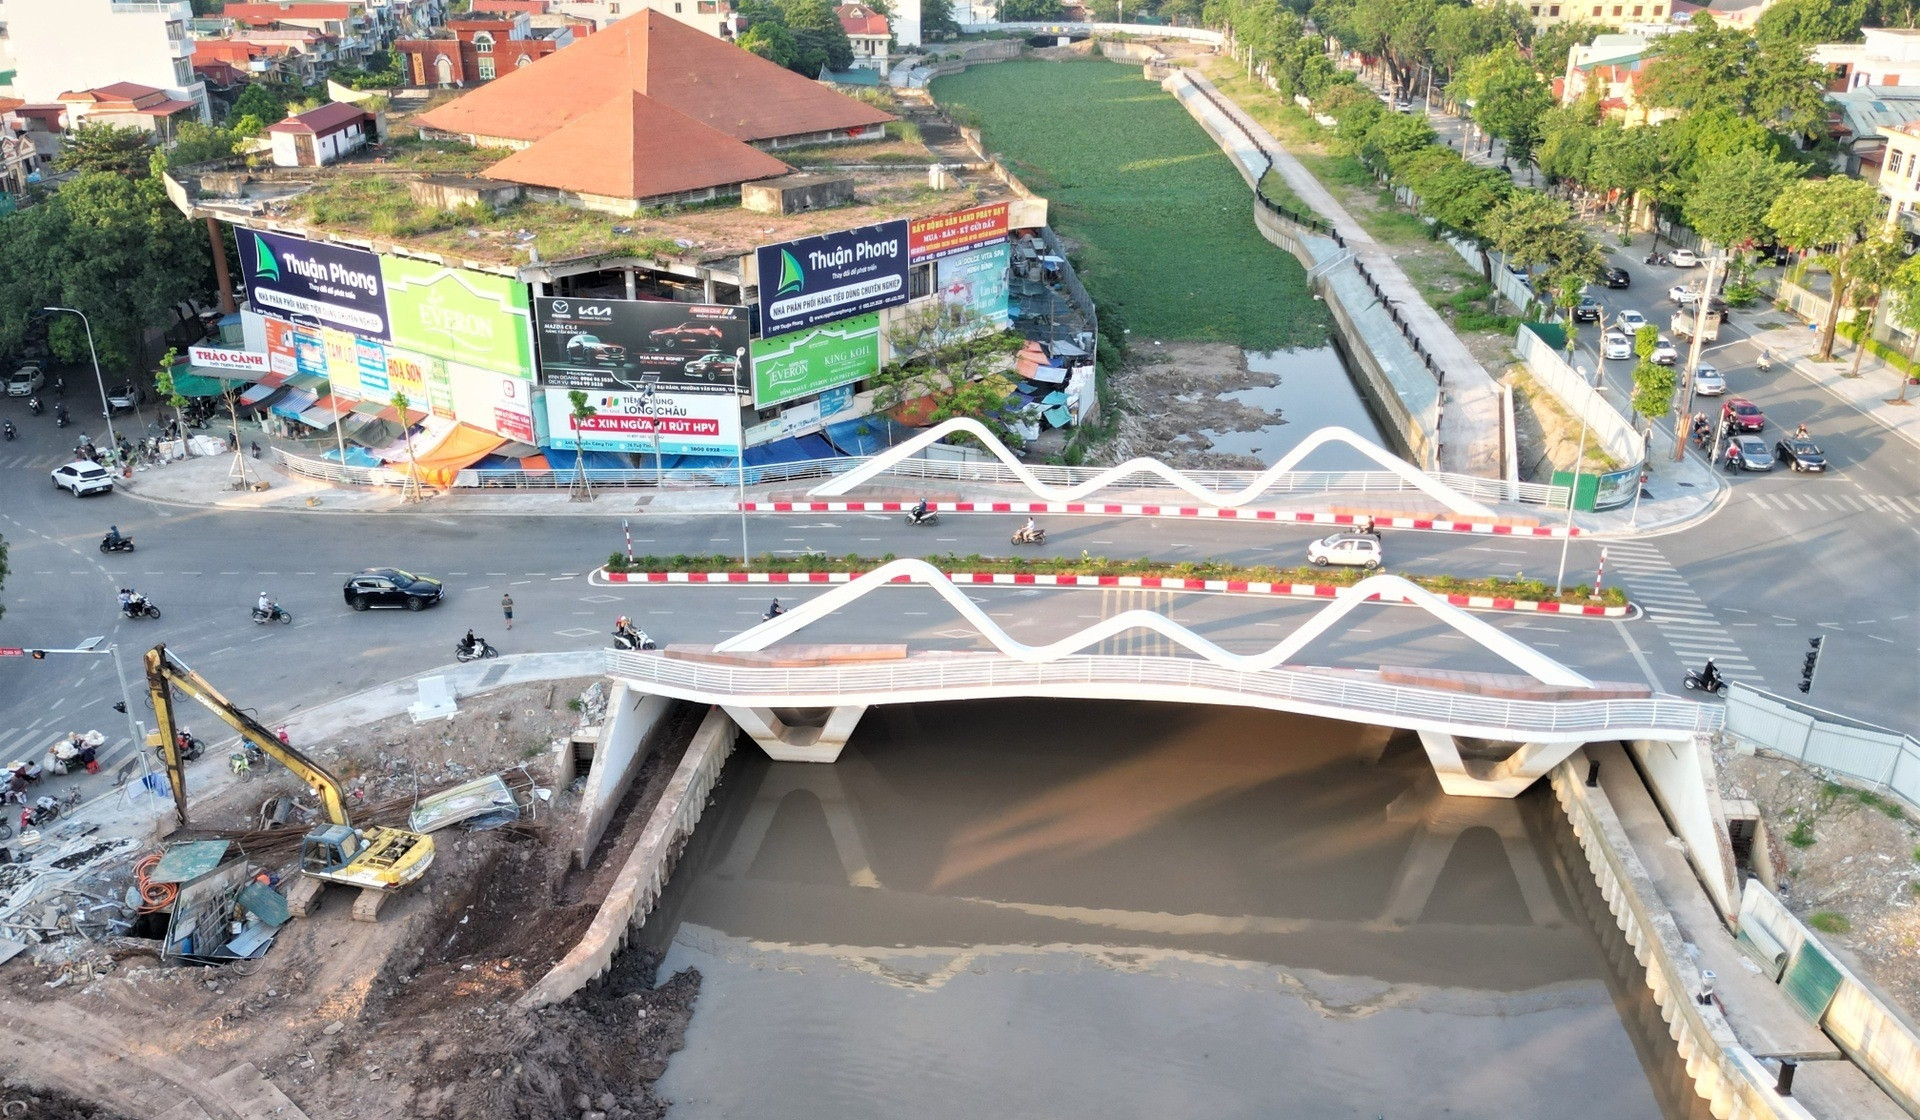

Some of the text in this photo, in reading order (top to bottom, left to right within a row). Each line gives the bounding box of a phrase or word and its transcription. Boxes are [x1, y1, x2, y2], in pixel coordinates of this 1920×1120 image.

[959, 212, 975, 224] LAND
[923, 233, 938, 243] MUA
[808, 246, 853, 270] Thuận
[856, 239, 898, 260] Phong
[963, 255, 980, 265] DOLCE
[981, 252, 993, 261] VITA
[994, 249, 1005, 258] SPA
[282, 252, 378, 296] Thuận Phong
[773, 304, 786, 317] NHÀ
[786, 300, 802, 314] PHÂN
[816, 294, 833, 307] HÀNG
[418, 303, 494, 340] EVERON
[824, 352, 847, 366] KING
[388, 358, 405, 379] HOA
[771, 364, 809, 382] EVERON
[624, 405, 688, 417] LONG CHÂU
[598, 419, 617, 429] XIN
[620, 416, 653, 431] NGỪA
[669, 420, 690, 432] RÚT
[692, 423, 717, 432] HPV
